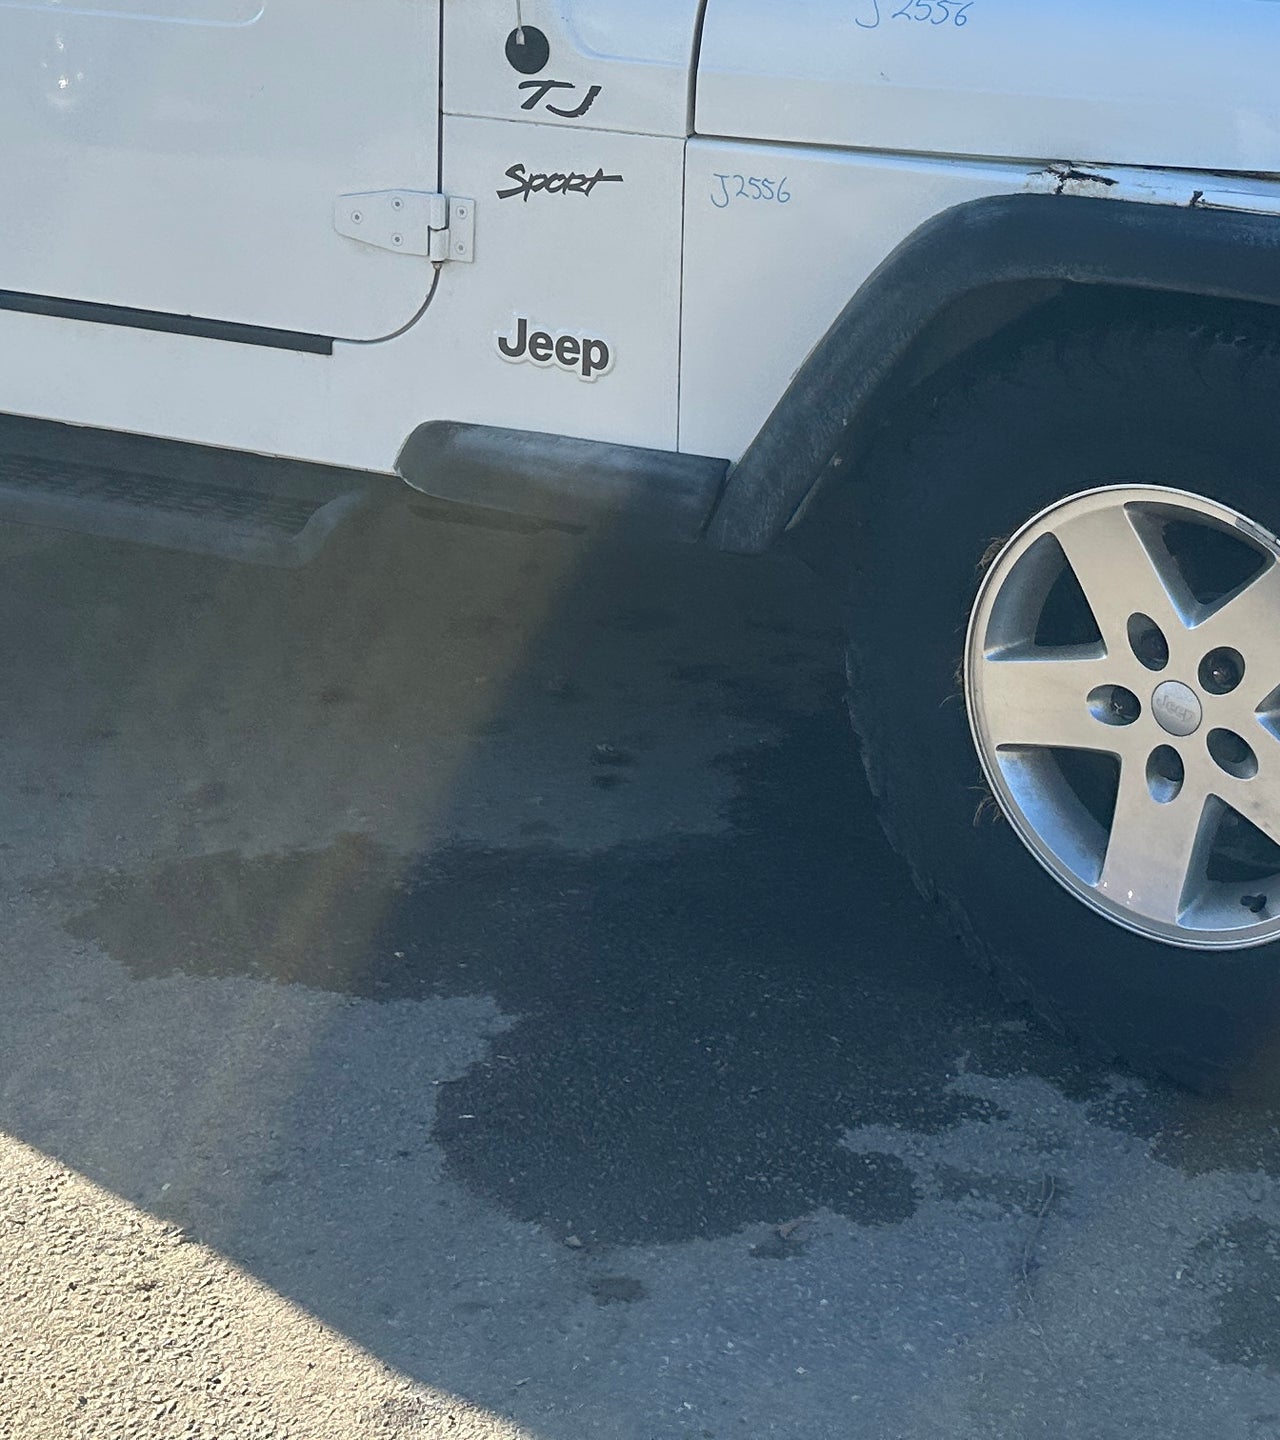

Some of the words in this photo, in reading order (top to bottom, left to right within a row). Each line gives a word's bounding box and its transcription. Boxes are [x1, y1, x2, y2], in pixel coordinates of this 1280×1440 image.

[518, 80, 602, 118] TJ
[710, 173, 791, 209] J2556
[497, 318, 609, 376] Jeep
